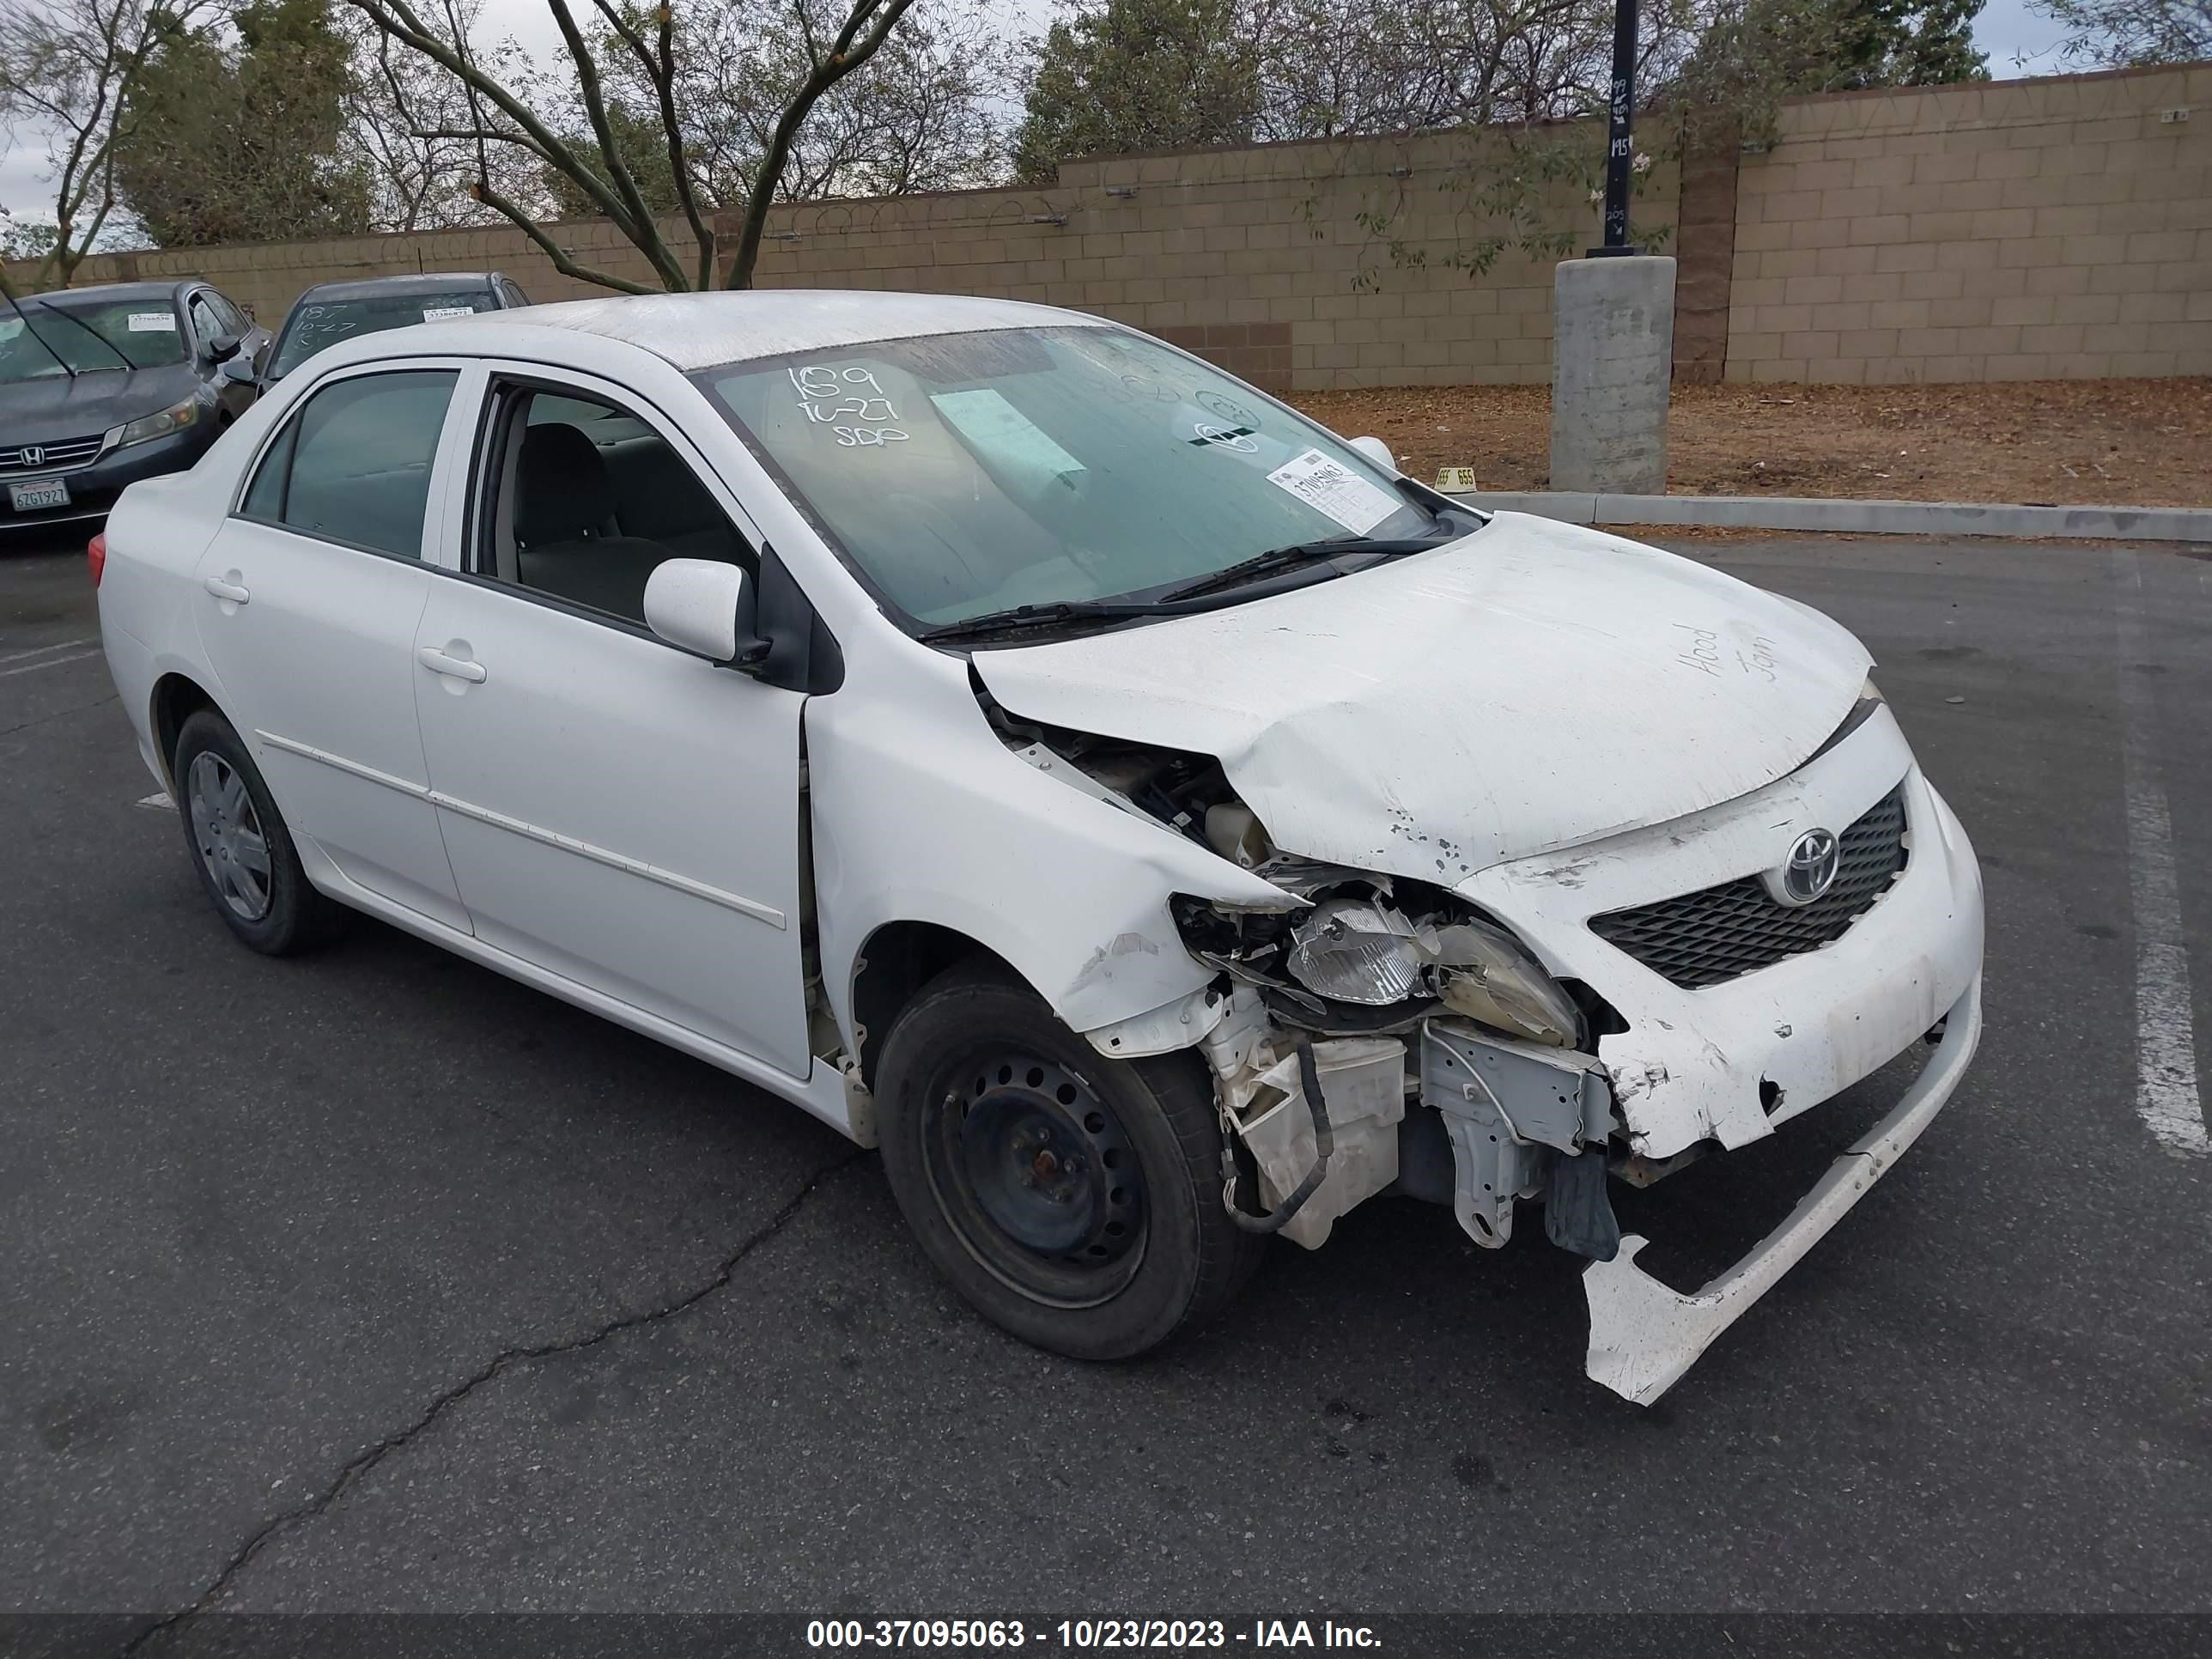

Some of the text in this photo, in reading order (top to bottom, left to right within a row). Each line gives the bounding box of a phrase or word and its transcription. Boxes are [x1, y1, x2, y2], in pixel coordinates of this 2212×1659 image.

[1613, 79, 1626, 94] 99
[787, 367, 884, 400] 189
[1293, 464, 1344, 497] 37095063
[1457, 469, 1474, 485] 655
[17, 489, 65, 507] 6ZGT927
[1672, 623, 1724, 678] Hood
